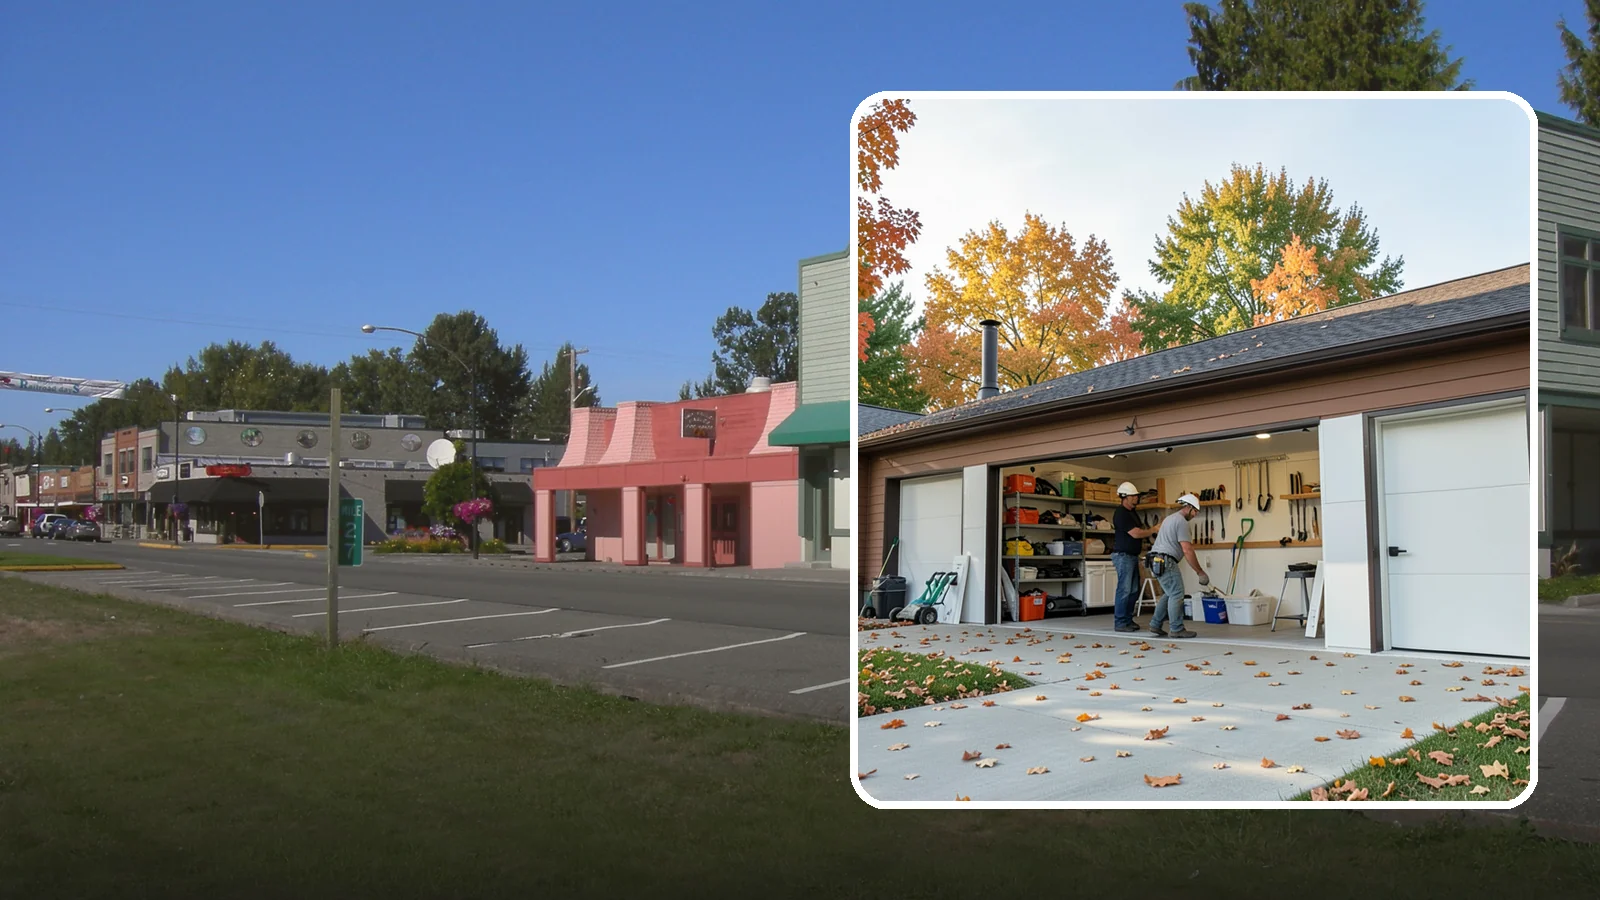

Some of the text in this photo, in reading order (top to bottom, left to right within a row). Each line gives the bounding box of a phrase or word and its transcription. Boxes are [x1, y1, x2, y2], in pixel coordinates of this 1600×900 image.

[20, 380, 57, 393] Railroad
[342, 505, 362, 517] MILE
[344, 522, 357, 560] 27
